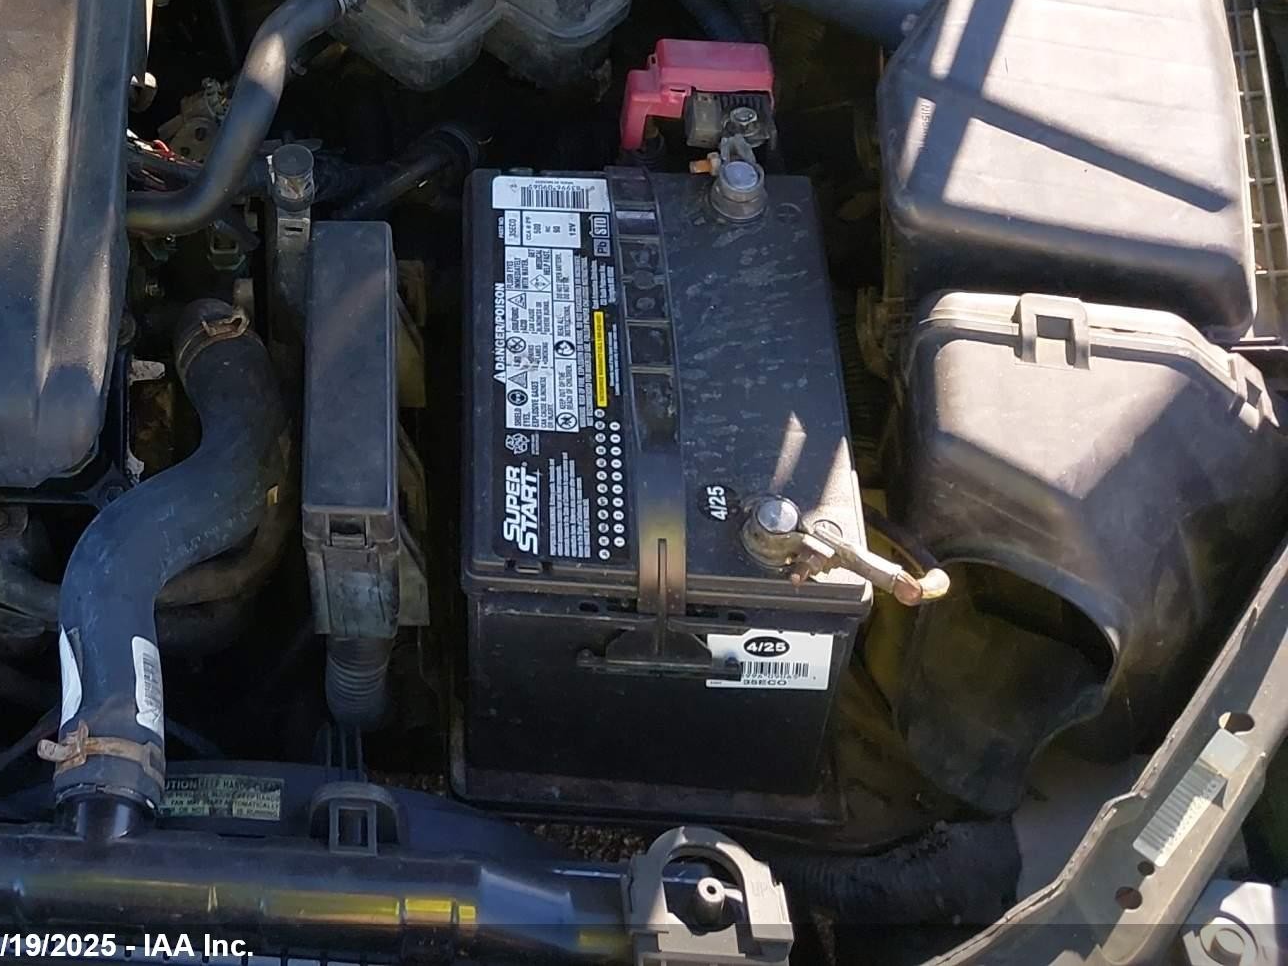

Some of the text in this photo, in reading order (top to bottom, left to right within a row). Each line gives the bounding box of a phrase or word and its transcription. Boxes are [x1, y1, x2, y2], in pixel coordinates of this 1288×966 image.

[593, 217, 607, 235] STD
[494, 283, 505, 370] DANGER/POISON
[531, 399, 539, 427] EXPLOSIVE
[503, 465, 520, 542] SUPER
[518, 466, 538, 555] START
[707, 486, 728, 520] 4/25
[746, 642, 786, 652] 4/25
[165, 777, 198, 791] UTION
